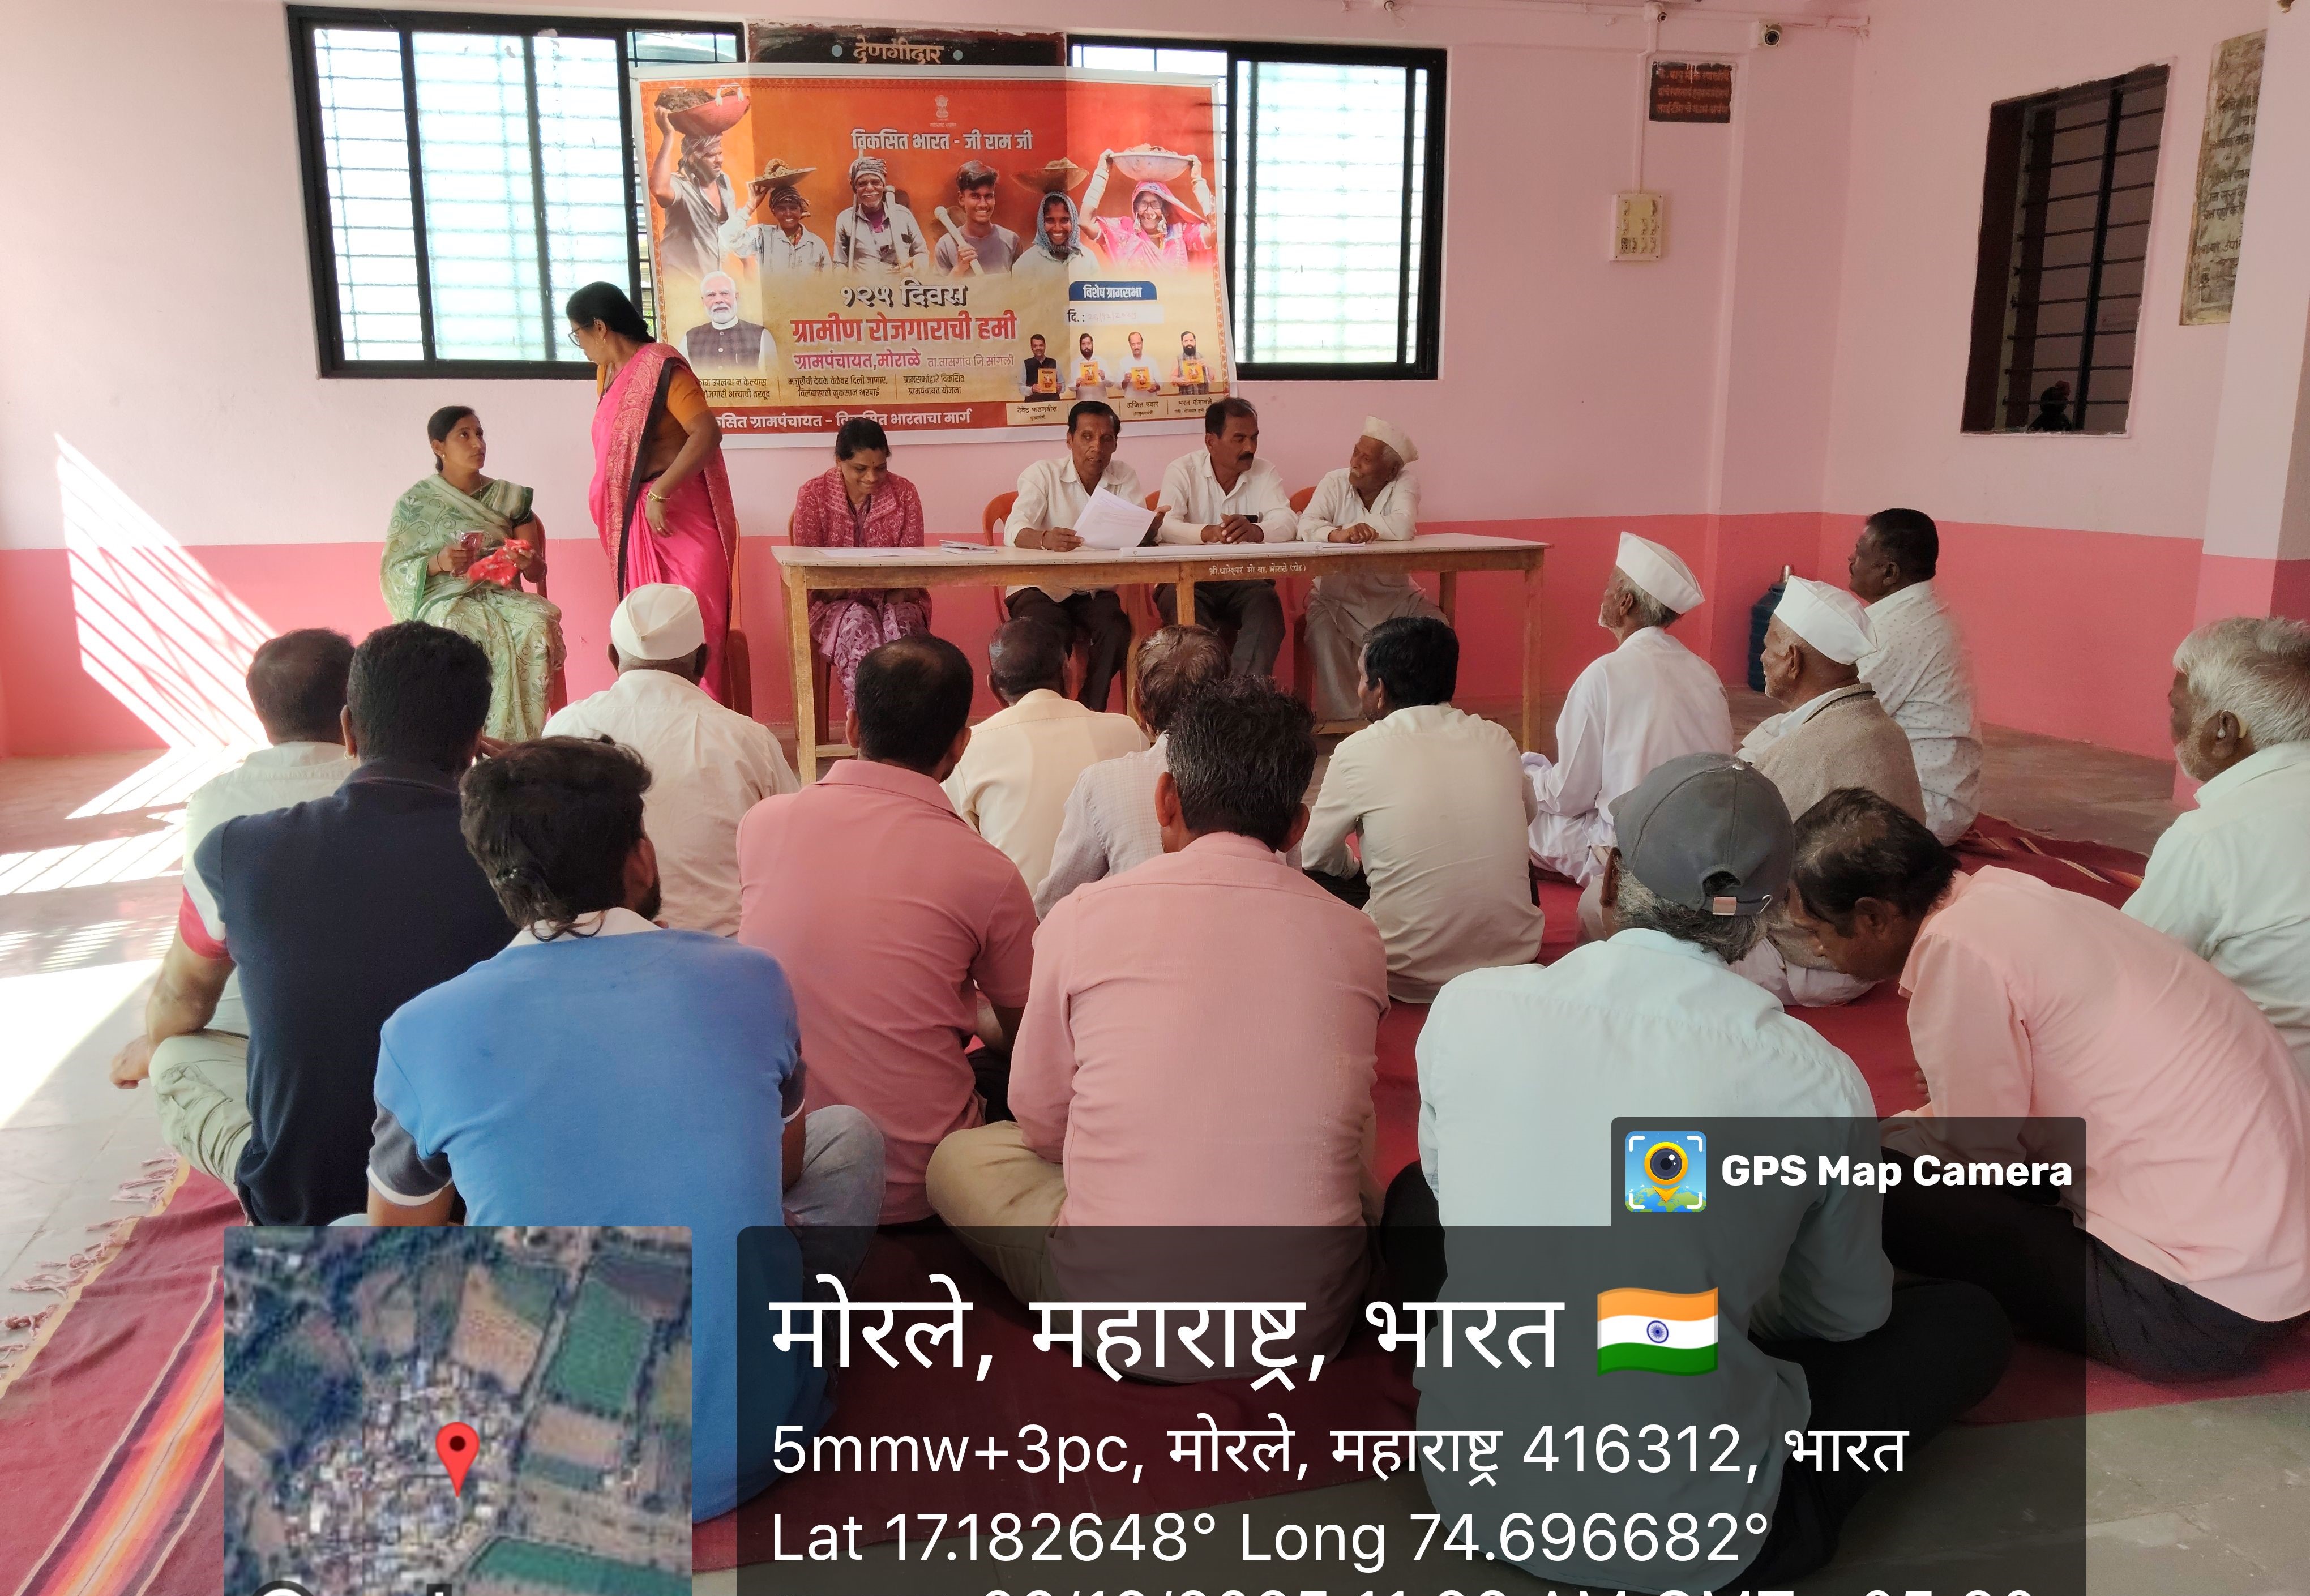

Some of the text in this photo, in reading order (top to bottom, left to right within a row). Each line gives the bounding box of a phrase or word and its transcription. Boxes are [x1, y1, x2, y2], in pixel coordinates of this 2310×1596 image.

[853, 34, 944, 64] देणगीदार
[852, 129, 909, 150] विकसित
[912, 133, 950, 150] भारत
[962, 129, 982, 150] जी
[983, 134, 1012, 150] राम
[1014, 129, 1033, 150] जी
[840, 276, 969, 309] १२५ दिवस
[1083, 284, 1106, 298] विशेष
[790, 310, 1017, 343] ग्रामीण रोजगाराची हमी
[850, 375, 865, 384] दिली
[941, 373, 965, 383] विकसित
[753, 390, 771, 400] तरतूद
[941, 385, 961, 395] योजना
[749, 412, 822, 429] ग्रामपंचायत
[891, 412, 942, 426] भारताचा
[943, 408, 972, 424] मार्ग
